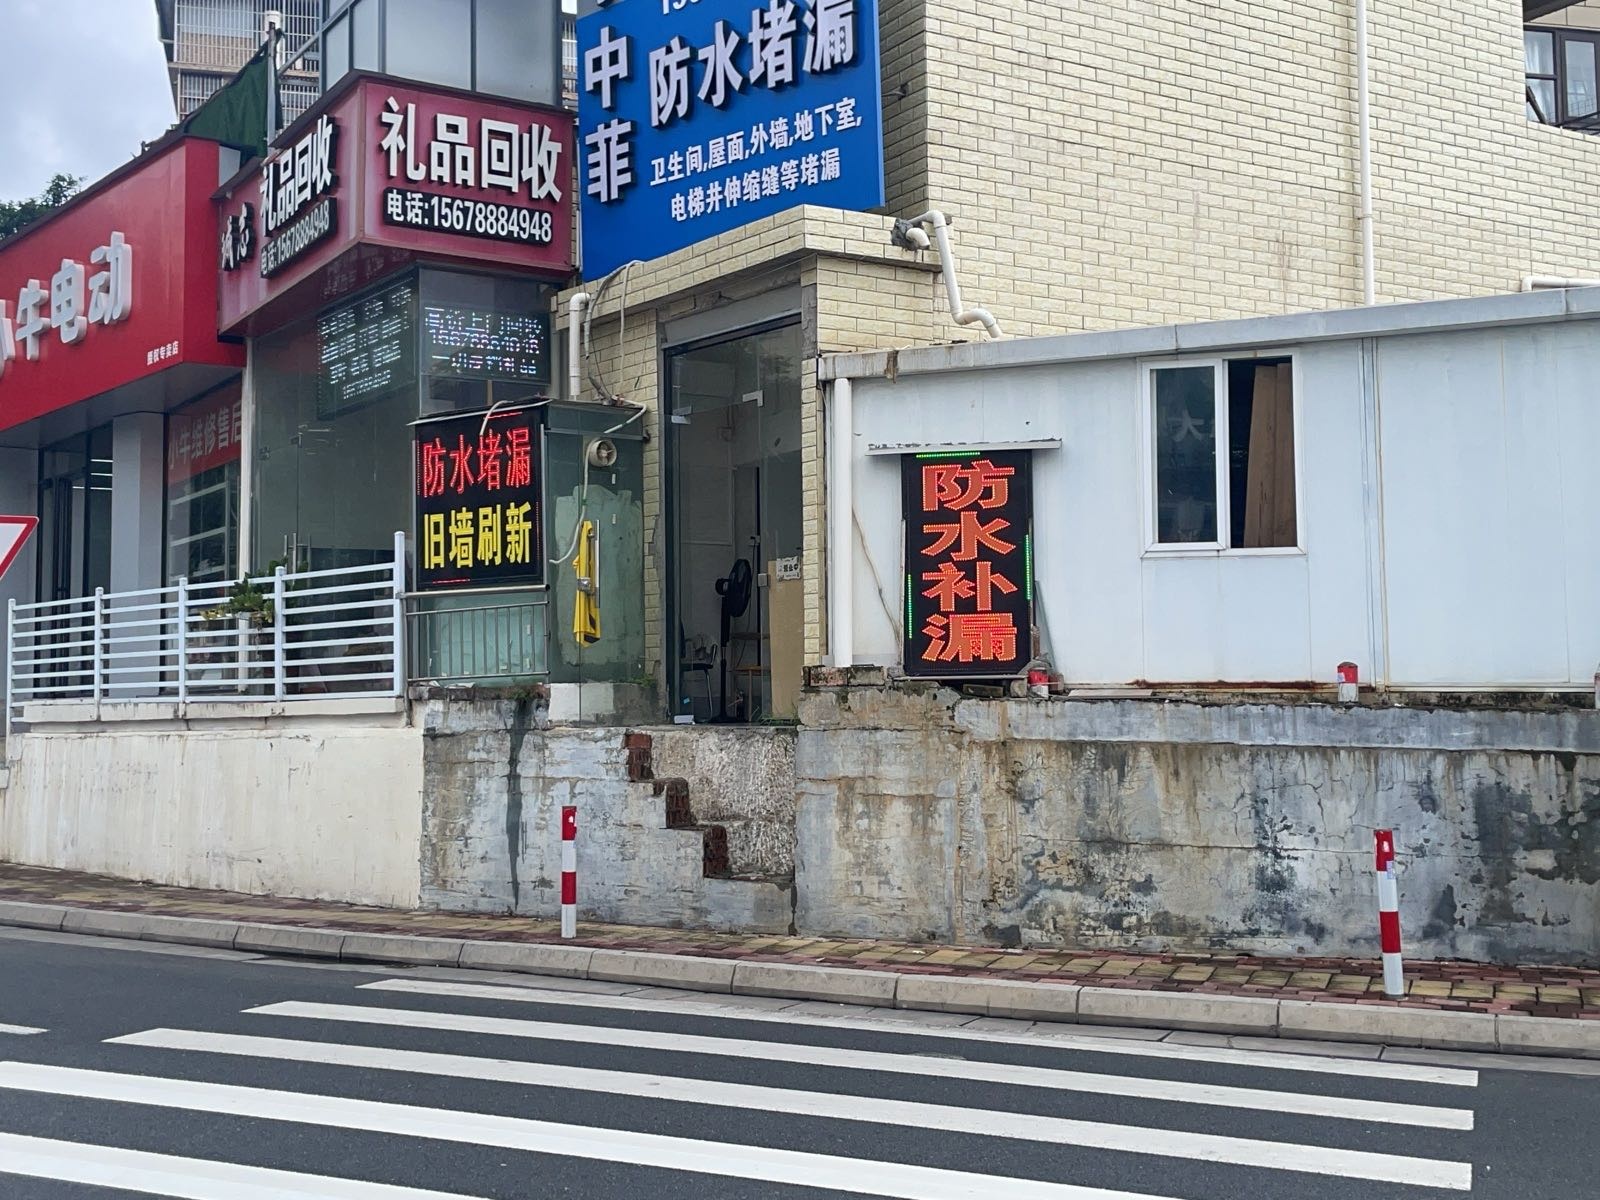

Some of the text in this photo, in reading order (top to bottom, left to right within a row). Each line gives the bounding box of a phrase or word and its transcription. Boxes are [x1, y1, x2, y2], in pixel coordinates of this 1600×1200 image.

[649, 0, 854, 128] 防水堵漏
[381, 96, 563, 203] 礼品回收
[584, 26, 633, 203] 中菲
[260, 114, 333, 237] 礼品回收
[387, 188, 553, 244] 电话:15678884948
[671, 148, 841, 222] 电梯井伸缩缝等堵漏
[260, 199, 330, 276] 电话:15678884948
[422, 428, 531, 498] 防水堵漏
[423, 501, 532, 569] 旧墙刷新
[920, 459, 1018, 662] 防水补漏
